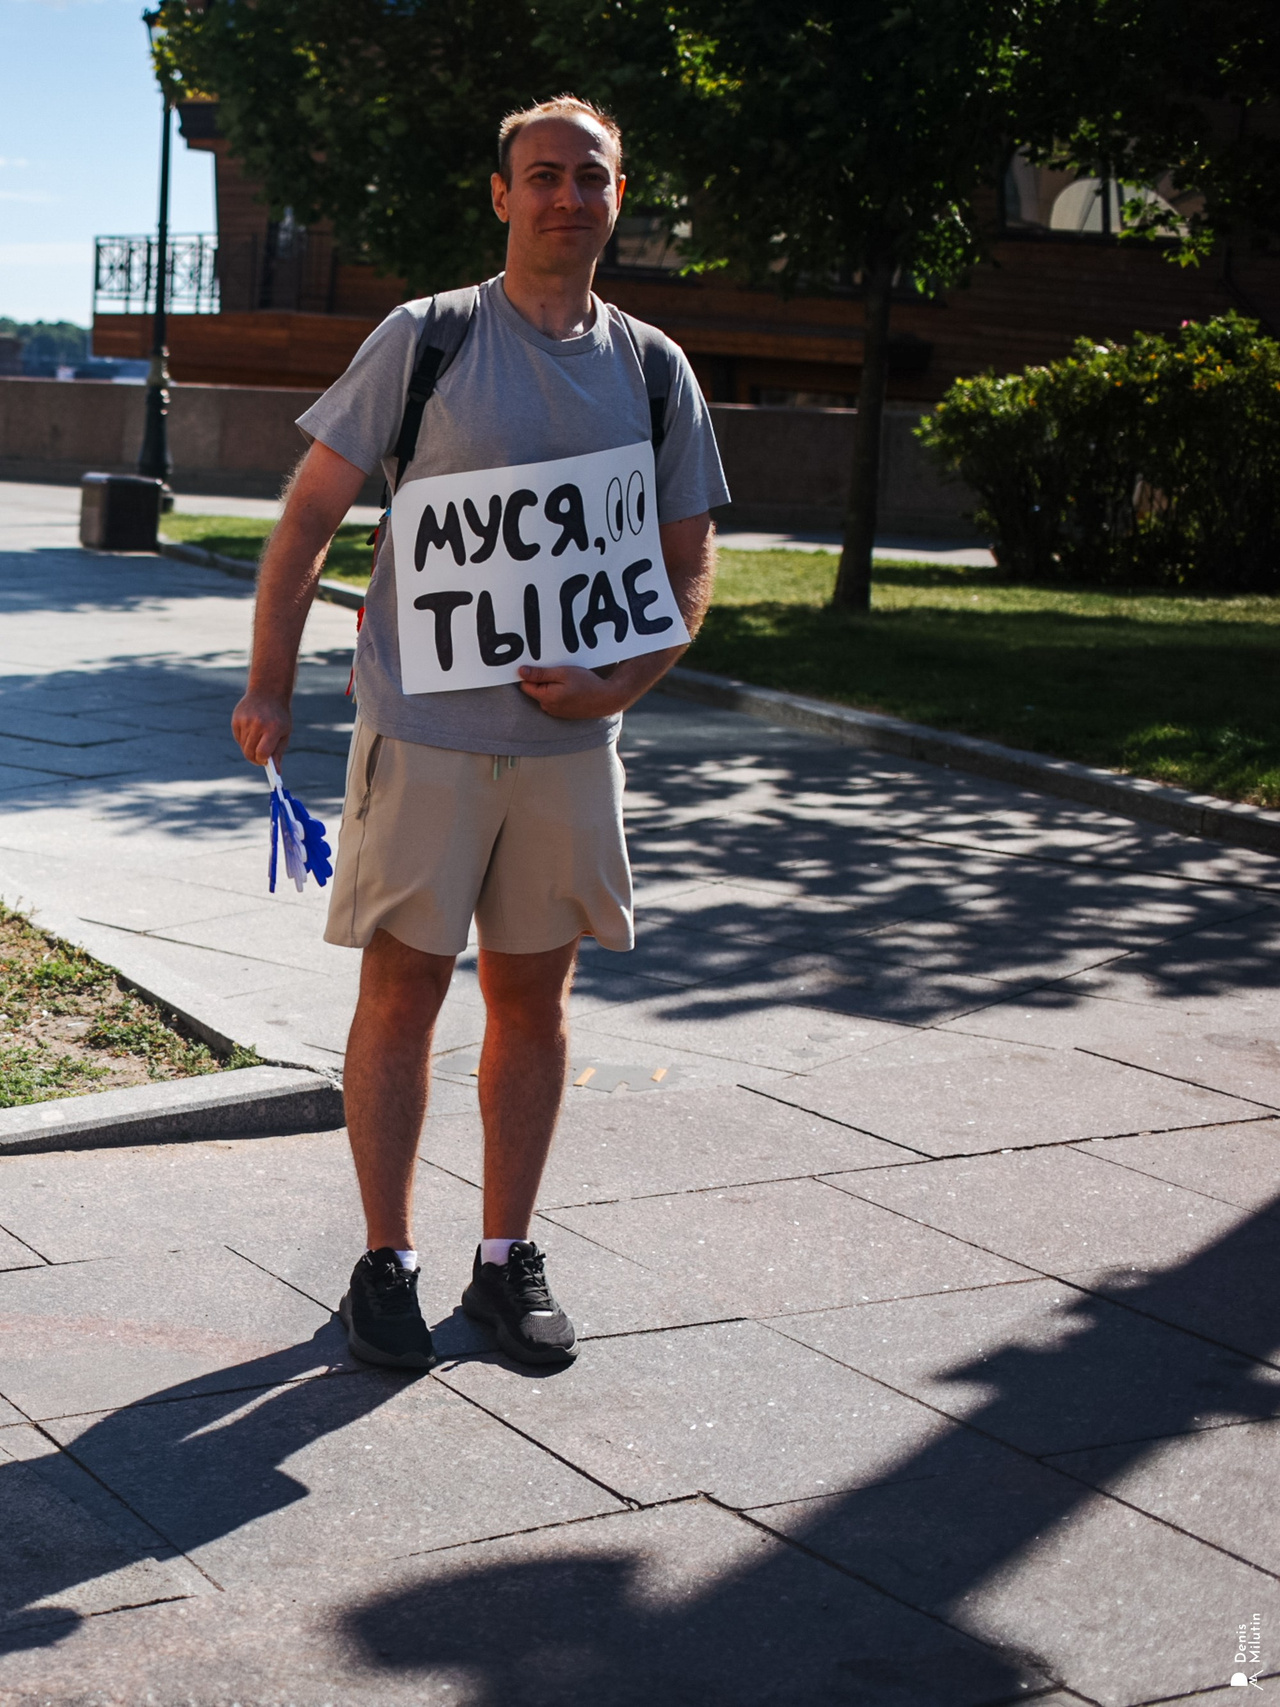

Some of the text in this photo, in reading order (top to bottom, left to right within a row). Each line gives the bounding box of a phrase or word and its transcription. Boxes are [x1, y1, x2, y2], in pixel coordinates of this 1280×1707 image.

[414, 483, 606, 572] МУСЯ,
[413, 558, 674, 672] ТЫ ГДЕ
